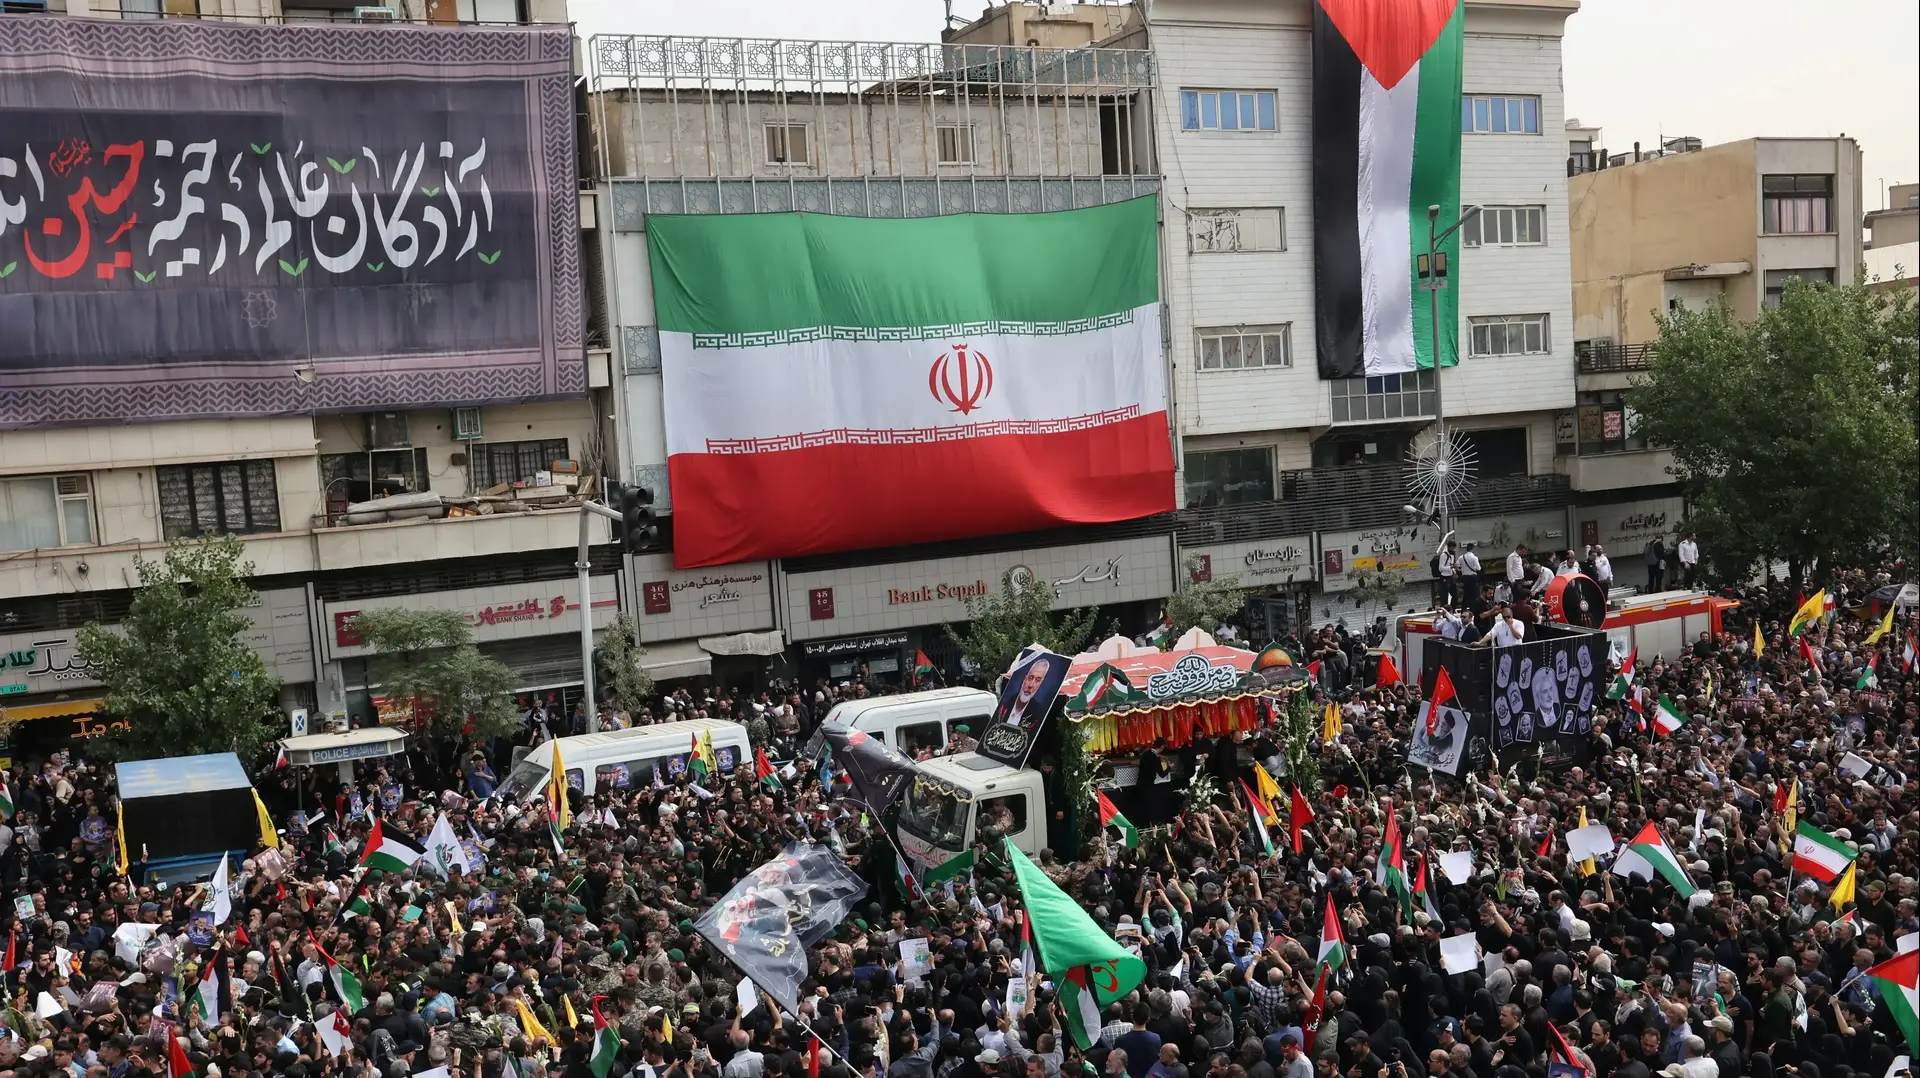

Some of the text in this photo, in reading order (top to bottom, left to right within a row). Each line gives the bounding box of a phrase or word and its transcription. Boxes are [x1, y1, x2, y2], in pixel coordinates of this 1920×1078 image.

[24, 139, 144, 278] حسین
[255, 140, 329, 276] عالم
[311, 137, 493, 273] آزادگان
[672, 574, 762, 592] موسسه فرهنگی هنری
[1052, 554, 1124, 598] بانک سپه
[700, 587, 741, 609] مشعر
[888, 580, 988, 605] Bank Sepah
[474, 598, 544, 626] بانک شهر
[496, 614, 535, 624] BANK SHAHR
[314, 748, 349, 762] POLICE
